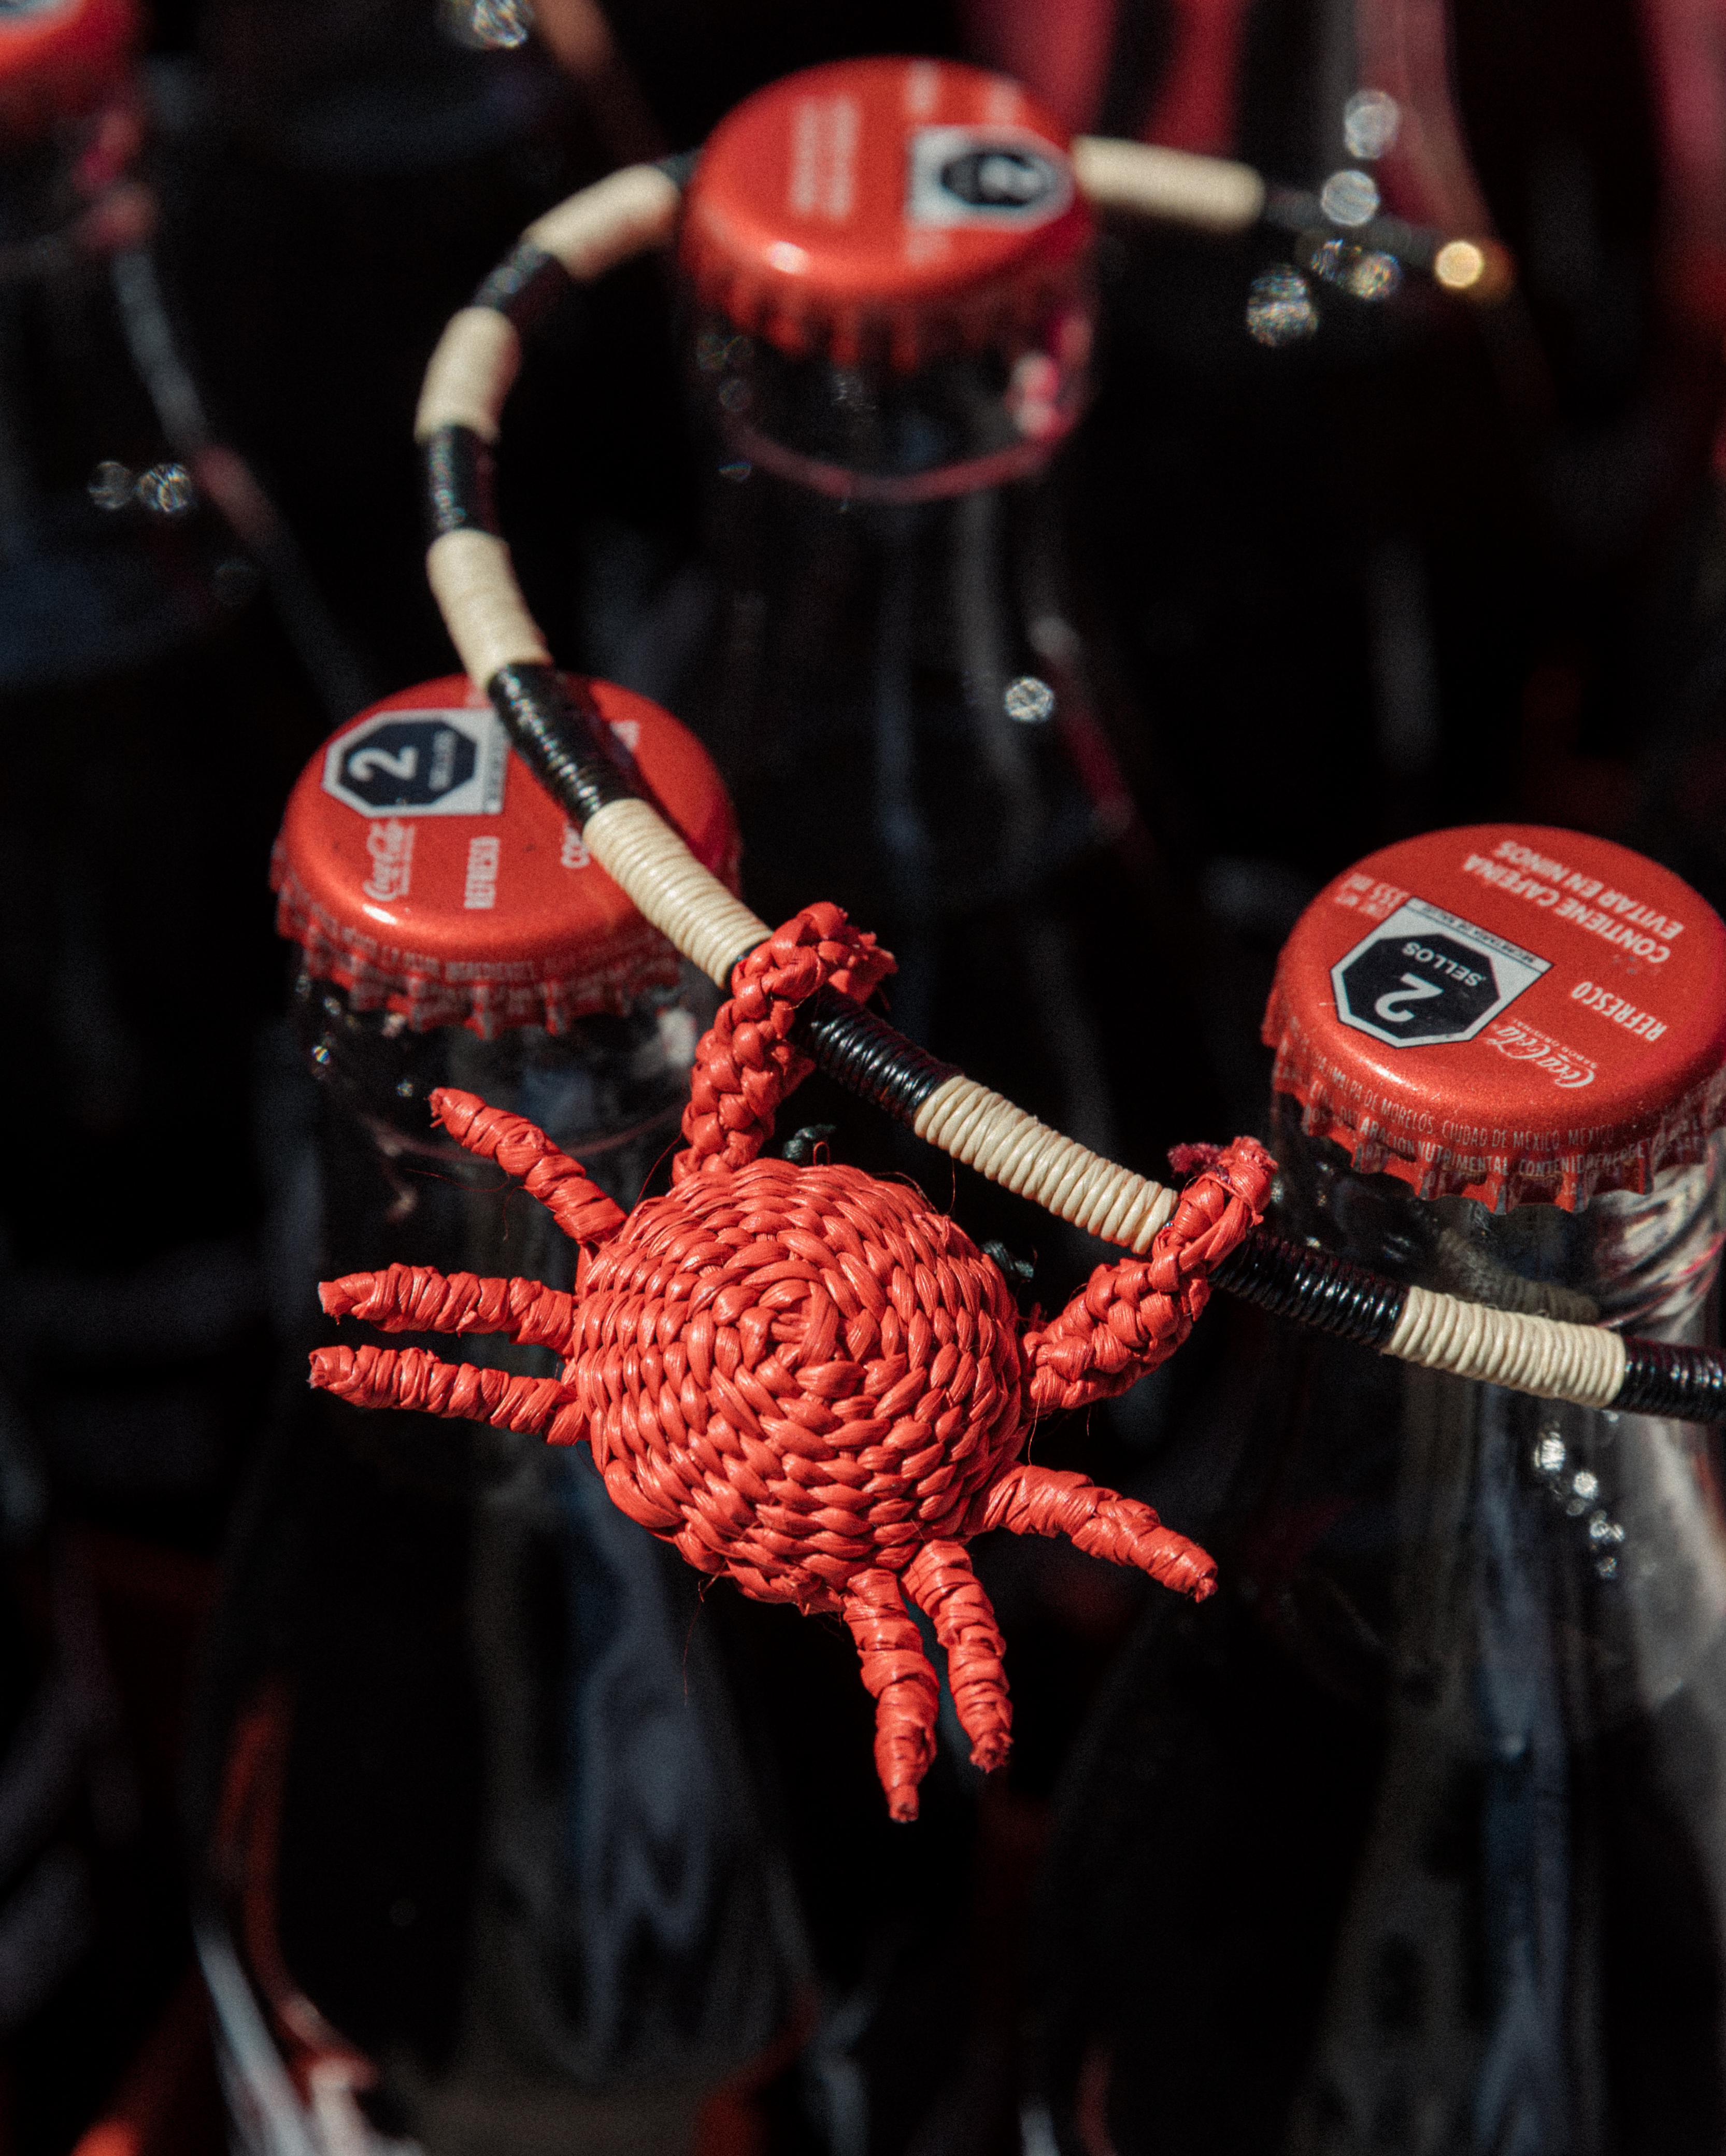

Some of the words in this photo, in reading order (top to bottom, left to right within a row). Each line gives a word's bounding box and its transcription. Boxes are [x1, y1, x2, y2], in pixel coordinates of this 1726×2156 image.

[348, 746, 418, 781] 2
[1563, 873, 1605, 899] EN
[1554, 897, 1671, 963] CONTIENE
[1599, 888, 1684, 940] EVITAR
[1402, 942, 1483, 986] SELLOS
[1375, 972, 1444, 1022] 2
[1571, 981, 1667, 1042] REFRESCO
[1364, 1089, 1378, 1112] DE
[1381, 1098, 1434, 1134] MORELOS
[1442, 1120, 1488, 1147] CIUDAD
[1492, 1128, 1507, 1148] DE
